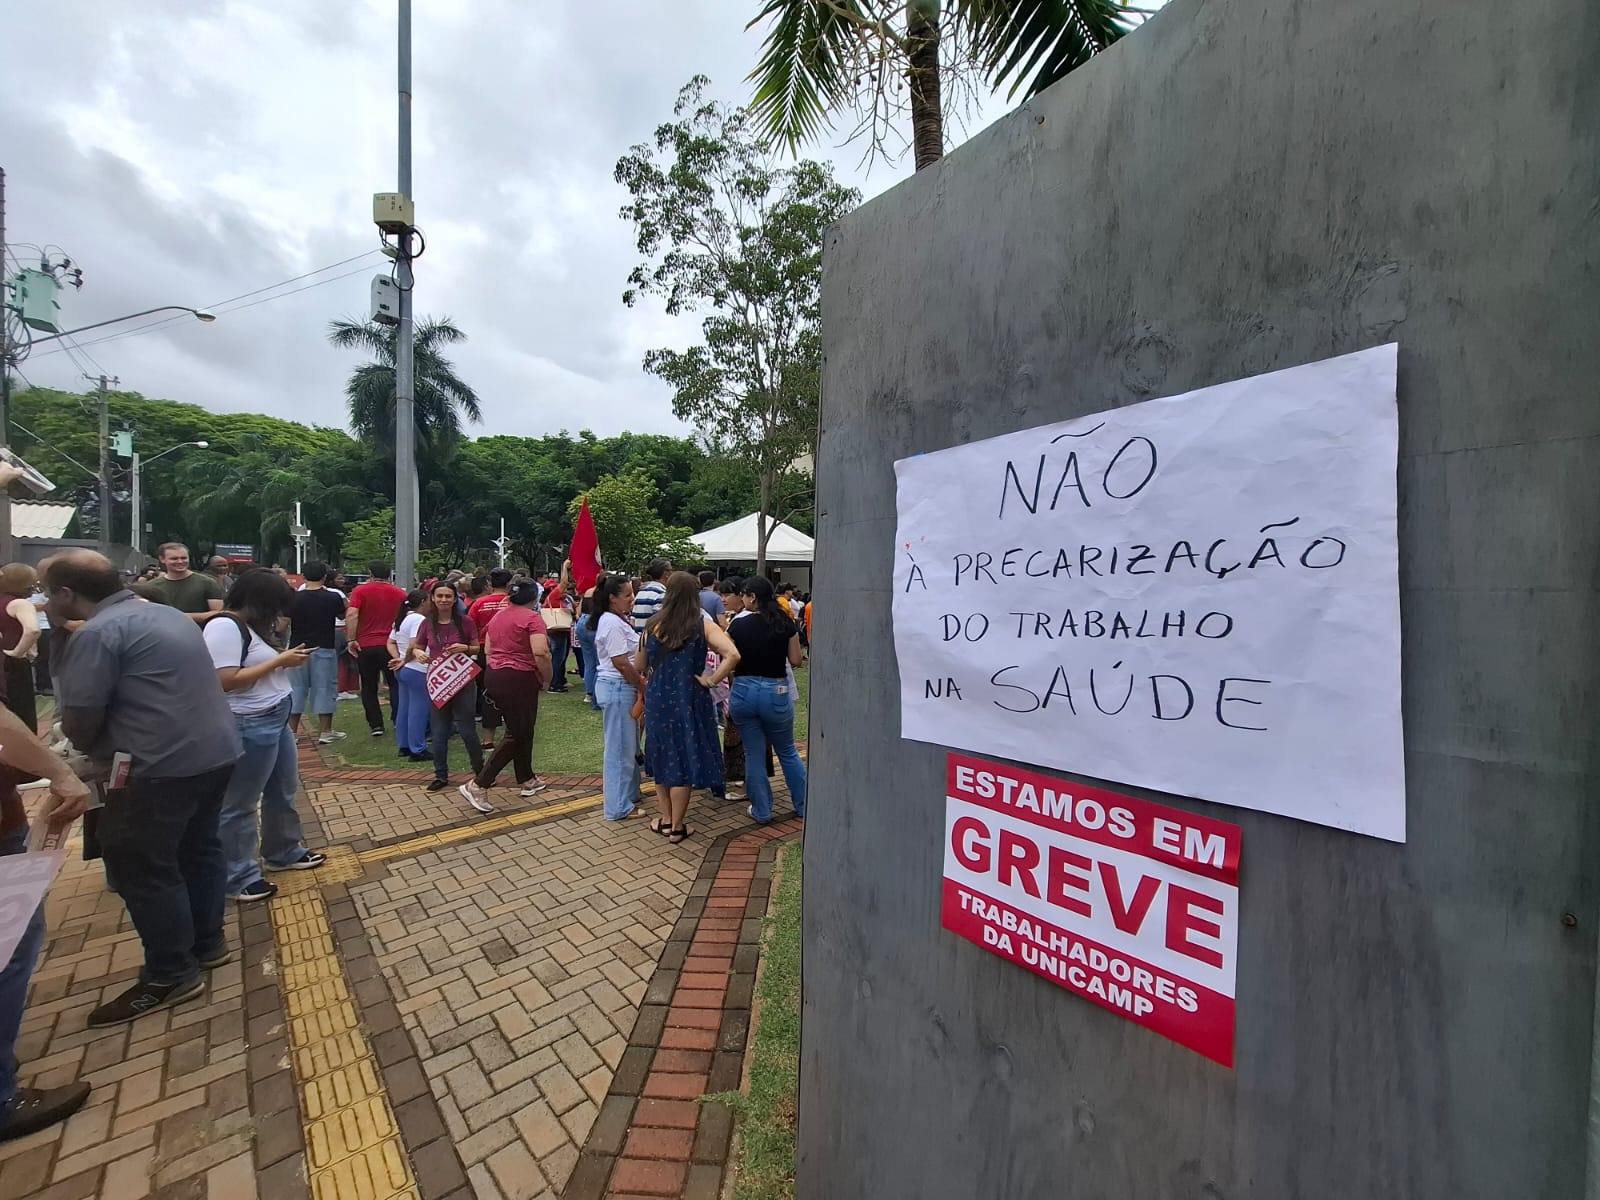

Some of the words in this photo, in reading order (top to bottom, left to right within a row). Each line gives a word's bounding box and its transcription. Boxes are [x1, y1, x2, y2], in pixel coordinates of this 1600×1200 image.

[998, 421, 1158, 520] NÃO
[904, 553, 927, 593] À
[953, 516, 1347, 586] PRECARIZAÇÃO
[940, 613, 989, 643] DO
[1010, 609, 1233, 640] TRABALHO
[428, 653, 469, 695] GREVE
[924, 678, 962, 702] NA
[990, 660, 1272, 731] SAÚDE
[955, 765, 1136, 839] ESTAMOS
[1152, 816, 1226, 870] EM
[950, 816, 1225, 970] GREVE
[957, 889, 1199, 1014] TRABALHADORES
[982, 925, 1014, 956] DA
[1022, 944, 1154, 1018] UNICAMP
